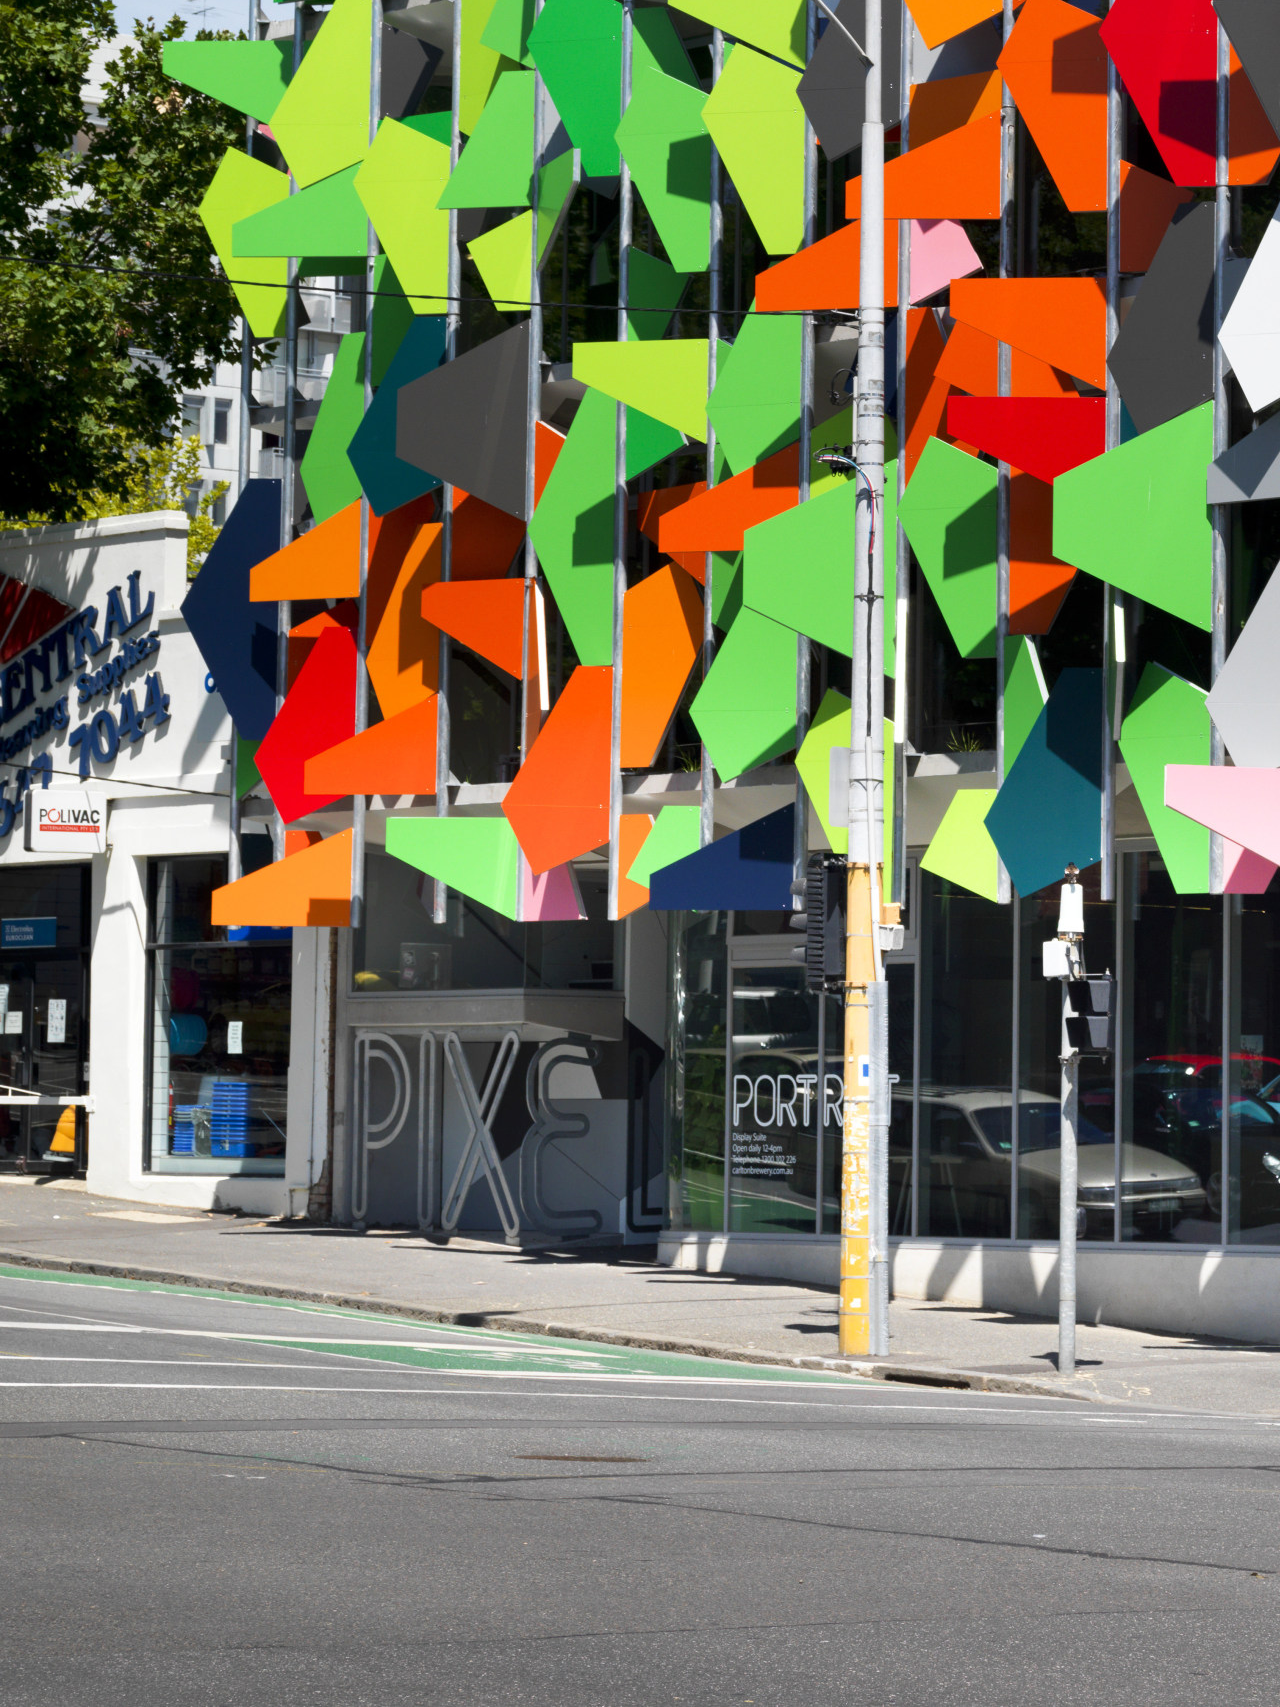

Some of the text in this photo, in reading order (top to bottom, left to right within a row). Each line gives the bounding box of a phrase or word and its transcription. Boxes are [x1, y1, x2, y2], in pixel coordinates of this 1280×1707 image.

[0, 570, 156, 725] ENTRAL
[76, 629, 161, 704] Supplies
[68, 670, 172, 783] 7044
[39, 808, 100, 824] POLIVAC
[732, 1074, 900, 1128] PORTRT
[732, 1133, 767, 1143] Display Suite
[732, 1144, 783, 1154] Open daily 12-4pm
[732, 1155, 761, 1165] Telephone
[761, 1156, 775, 1164] 1300
[785, 1155, 797, 1164] 226
[731, 1166, 794, 1176] carltonbrewery.com.au
